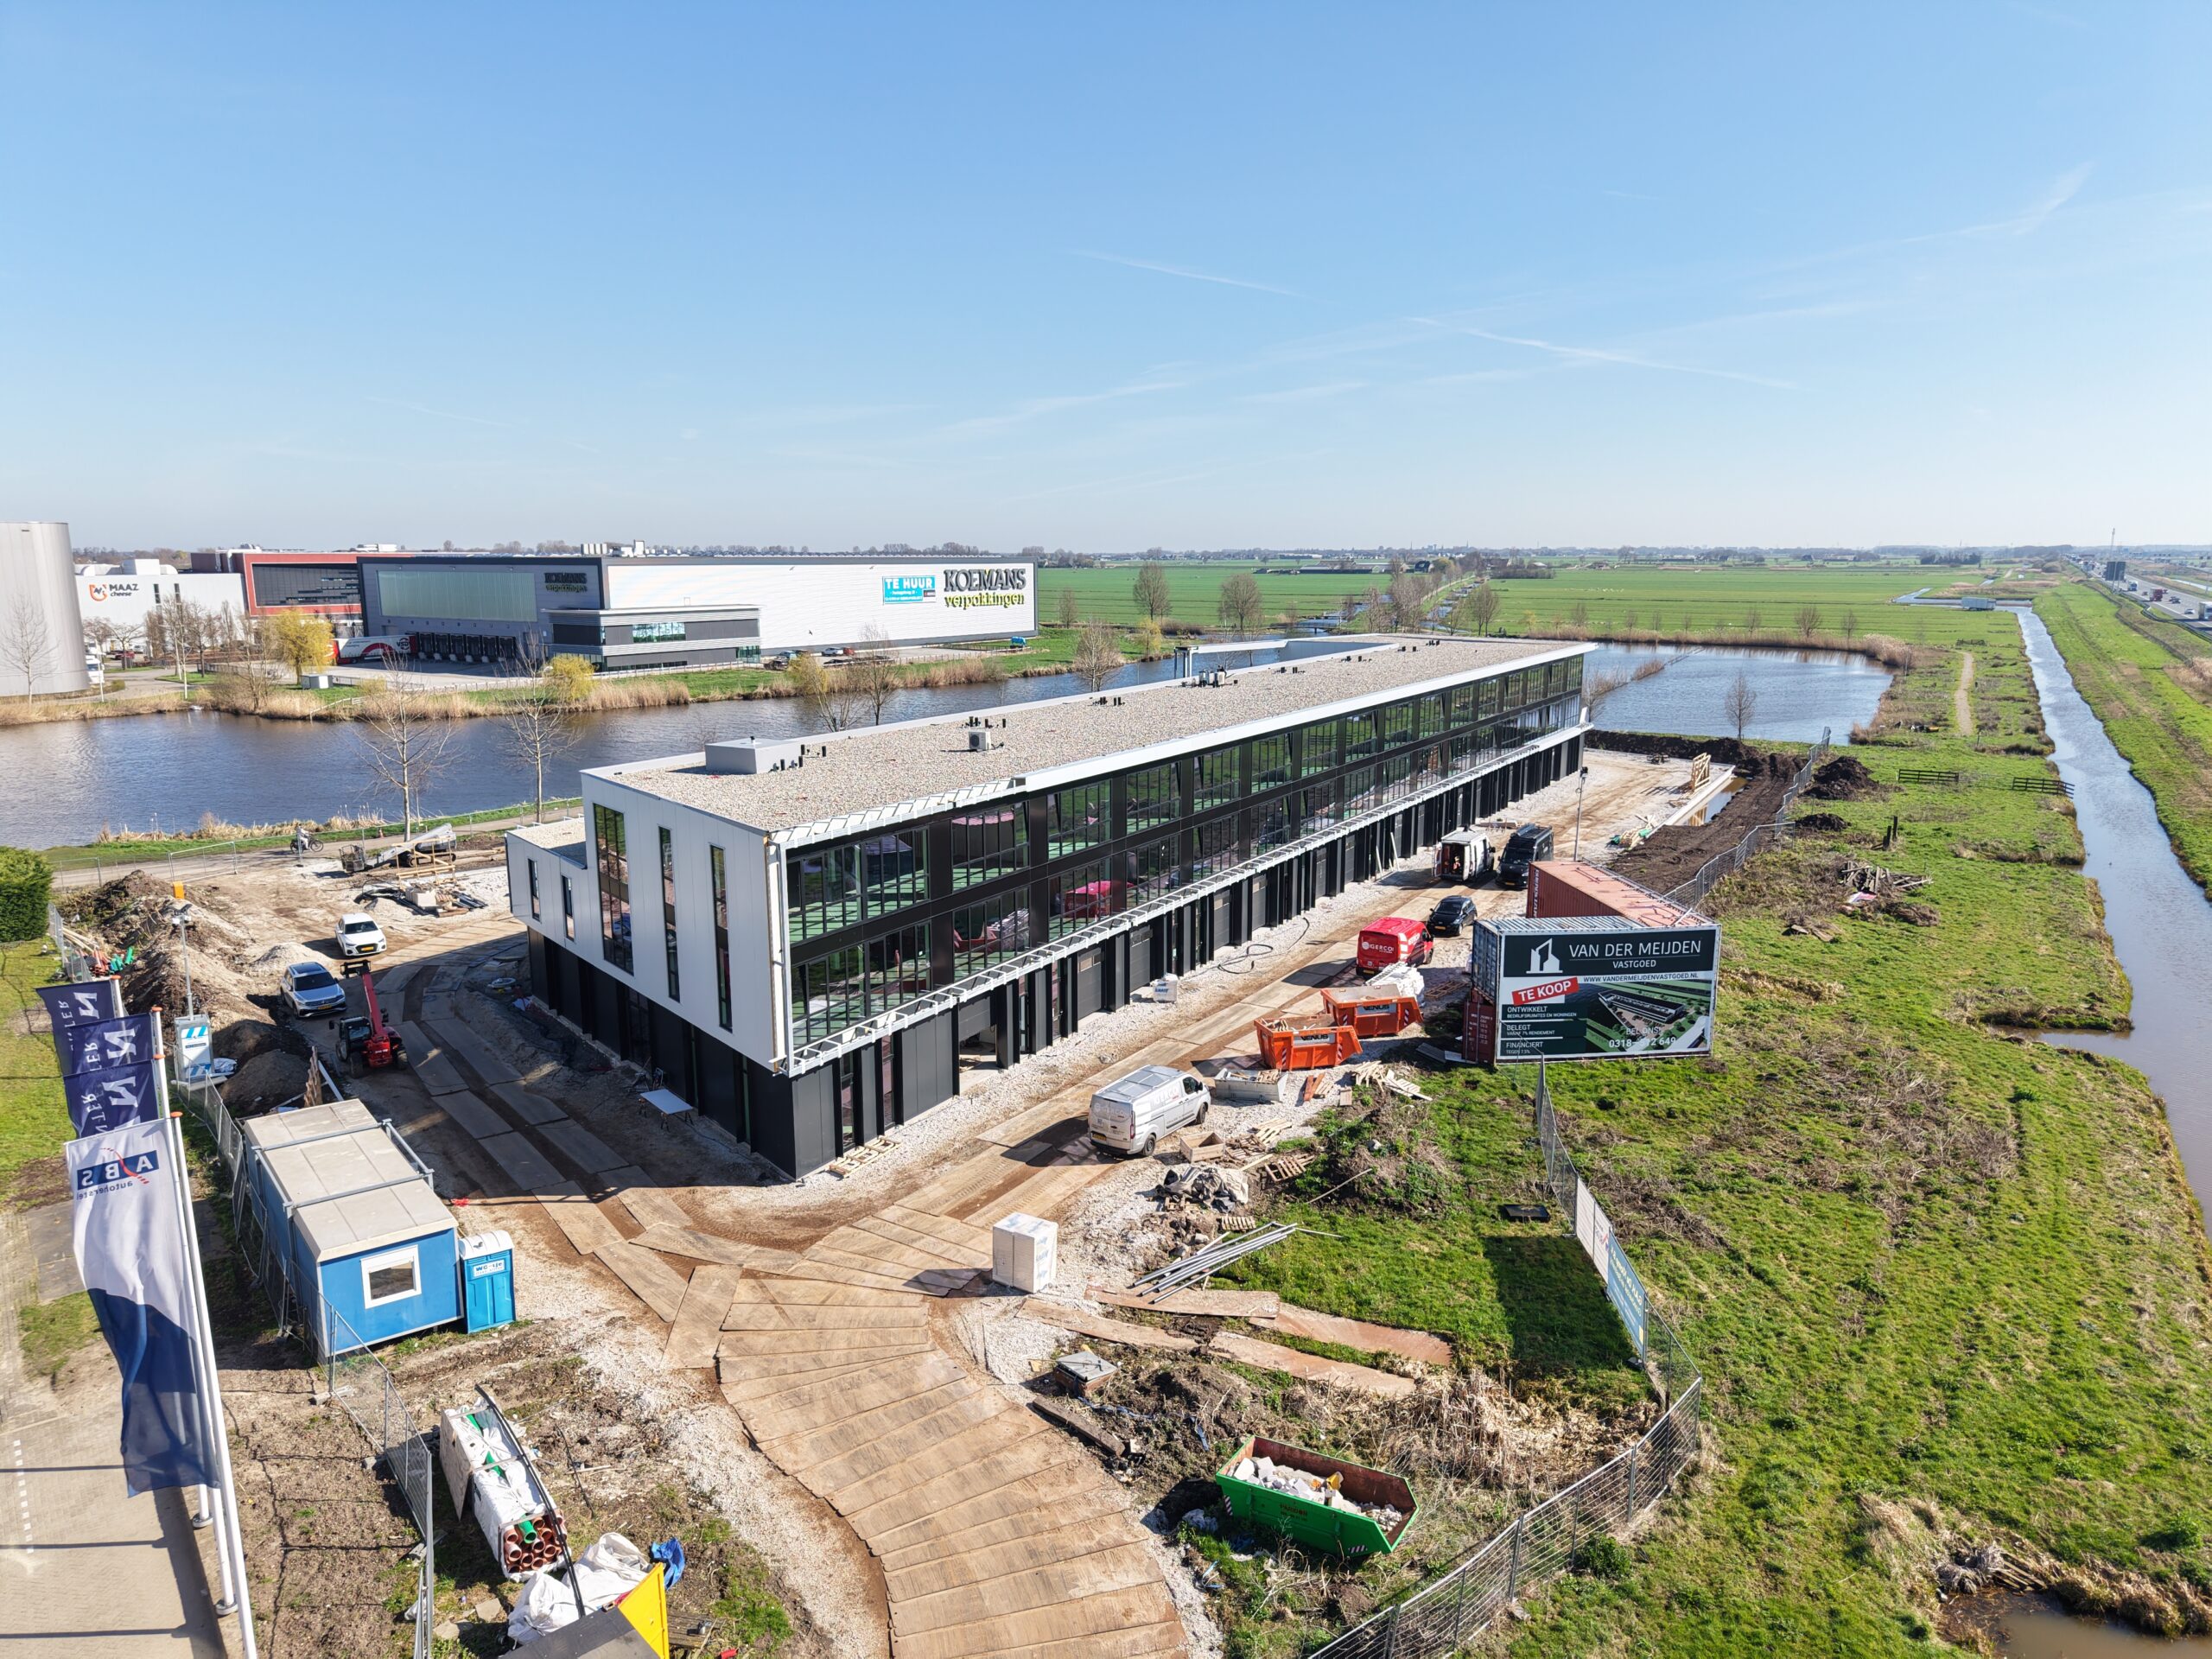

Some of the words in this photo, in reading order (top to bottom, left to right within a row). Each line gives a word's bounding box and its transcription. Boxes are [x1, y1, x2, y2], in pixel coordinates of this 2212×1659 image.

[885, 578, 899, 589] TE
[903, 576, 933, 588] HUUR
[944, 569, 1027, 592] KOEMANS
[944, 591, 1026, 610] verpakkingen
[1569, 944, 1599, 958] VAN
[1605, 943, 1633, 957] DER
[1638, 940, 1701, 956] MEIJDEN
[1612, 959, 1656, 969] VASTGOED
[1518, 988, 1535, 1001] TE
[1537, 981, 1572, 998] KOOP
[1658, 1036, 1676, 1046] 649
